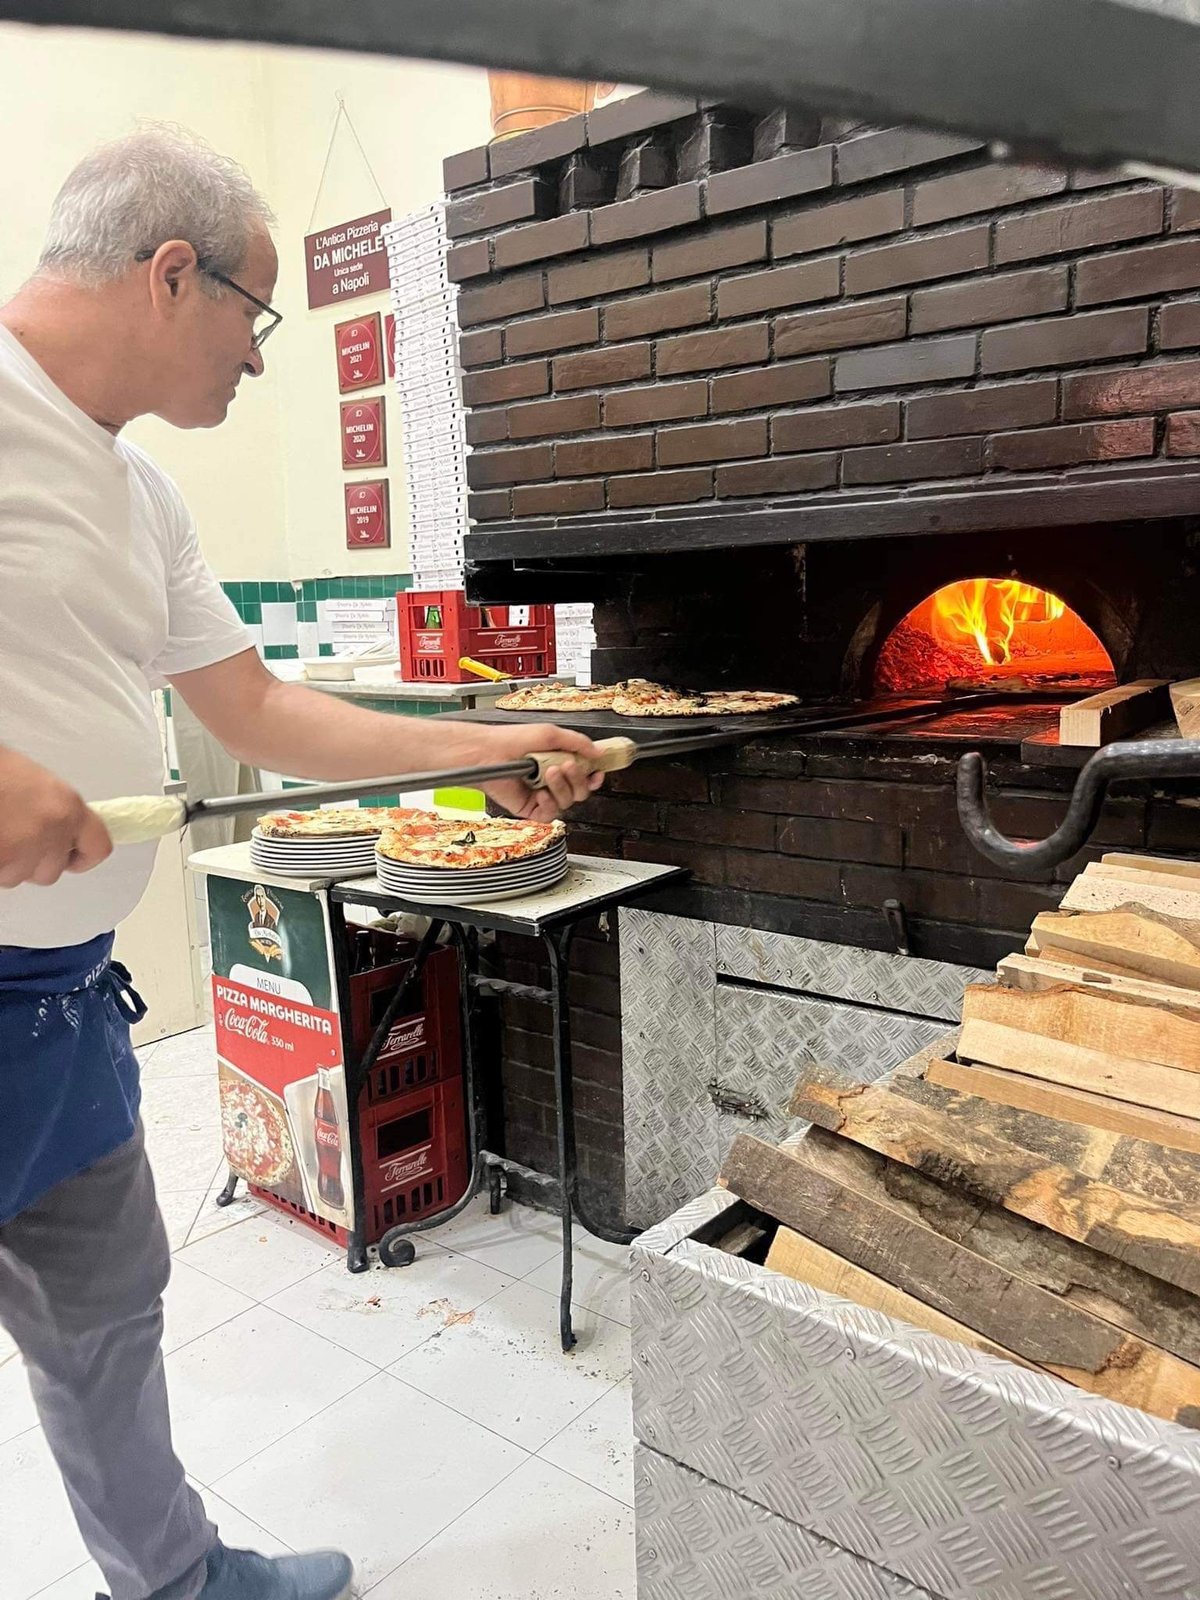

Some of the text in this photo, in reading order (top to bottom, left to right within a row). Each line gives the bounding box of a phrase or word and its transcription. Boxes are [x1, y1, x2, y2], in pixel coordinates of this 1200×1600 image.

[315, 220, 379, 250] L'Antica Pizzeria
[313, 236, 384, 271] DA MICHELE
[334, 262, 364, 277] Unica sede
[332, 272, 370, 295] a Napoli
[341, 341, 371, 356] MICHELIN
[345, 423, 374, 434] MICHELIN
[349, 505, 377, 515] MICHELIN
[256, 977, 281, 995] MENU
[216, 984, 332, 1036] PIZZA MARGHERITA
[224, 1008, 269, 1044] Coca-Cola
